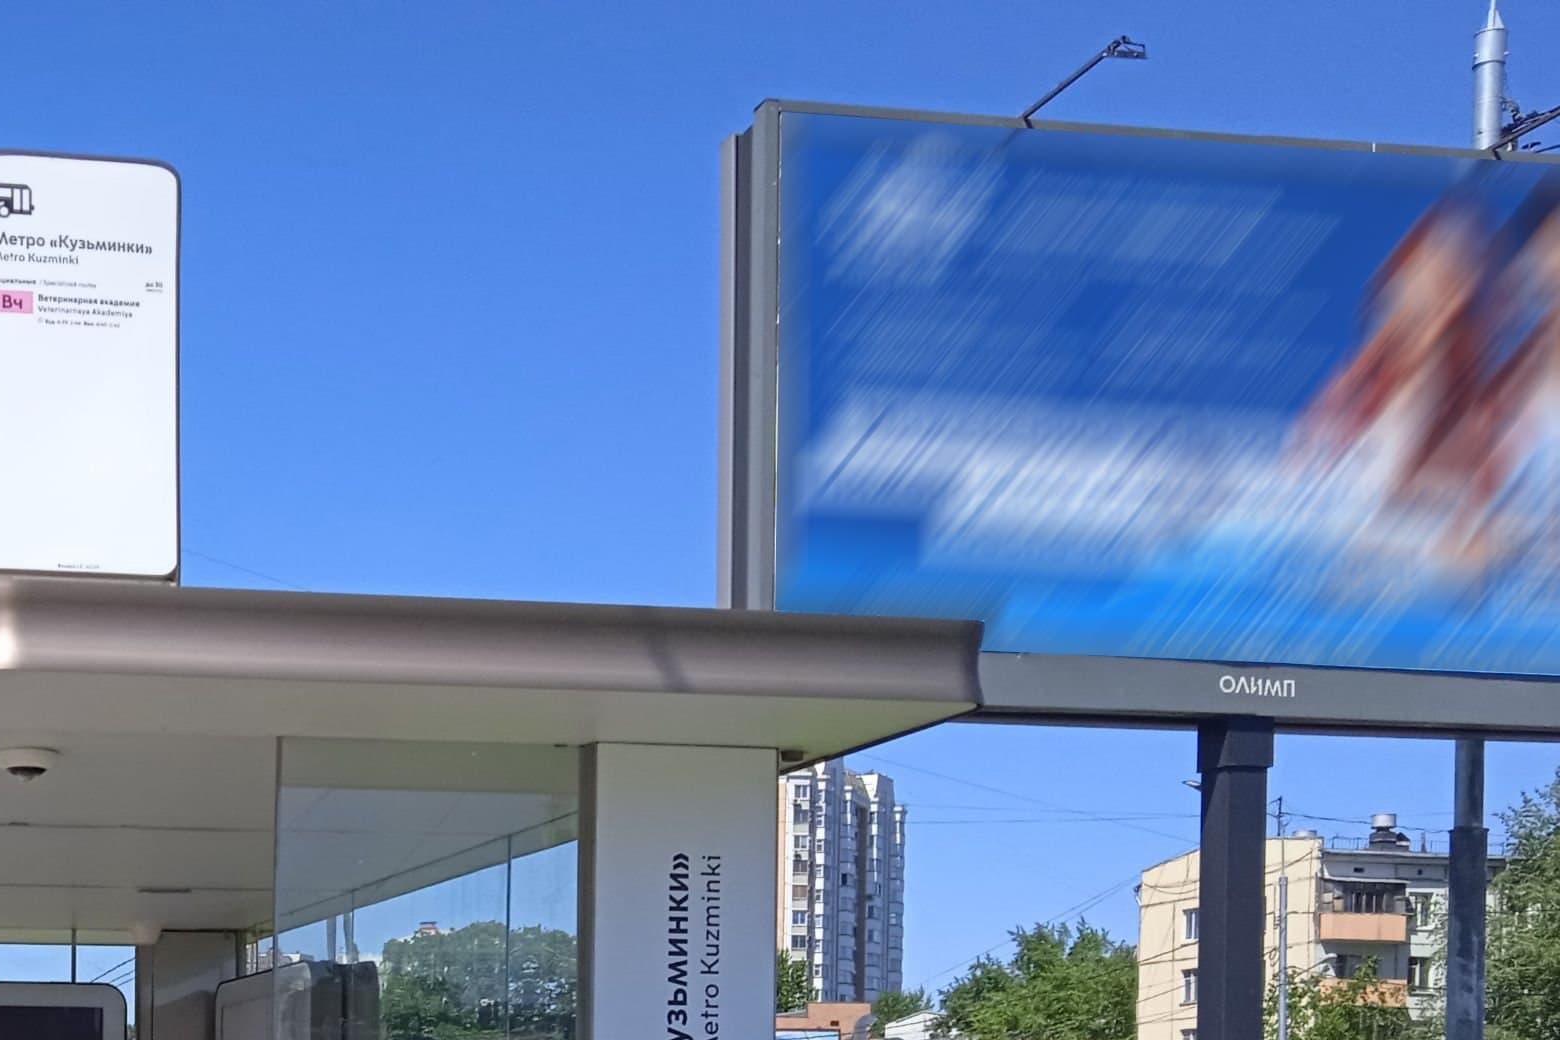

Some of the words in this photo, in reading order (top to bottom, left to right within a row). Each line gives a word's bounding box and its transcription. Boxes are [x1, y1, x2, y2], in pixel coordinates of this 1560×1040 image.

[50, 235, 153, 255] «Кузьминки»
[28, 253, 79, 265] Kuzminki
[2, 294, 23, 310] Вч
[1219, 675, 1295, 698] ОЛИМП
[700, 855, 721, 975] Kuzminki
